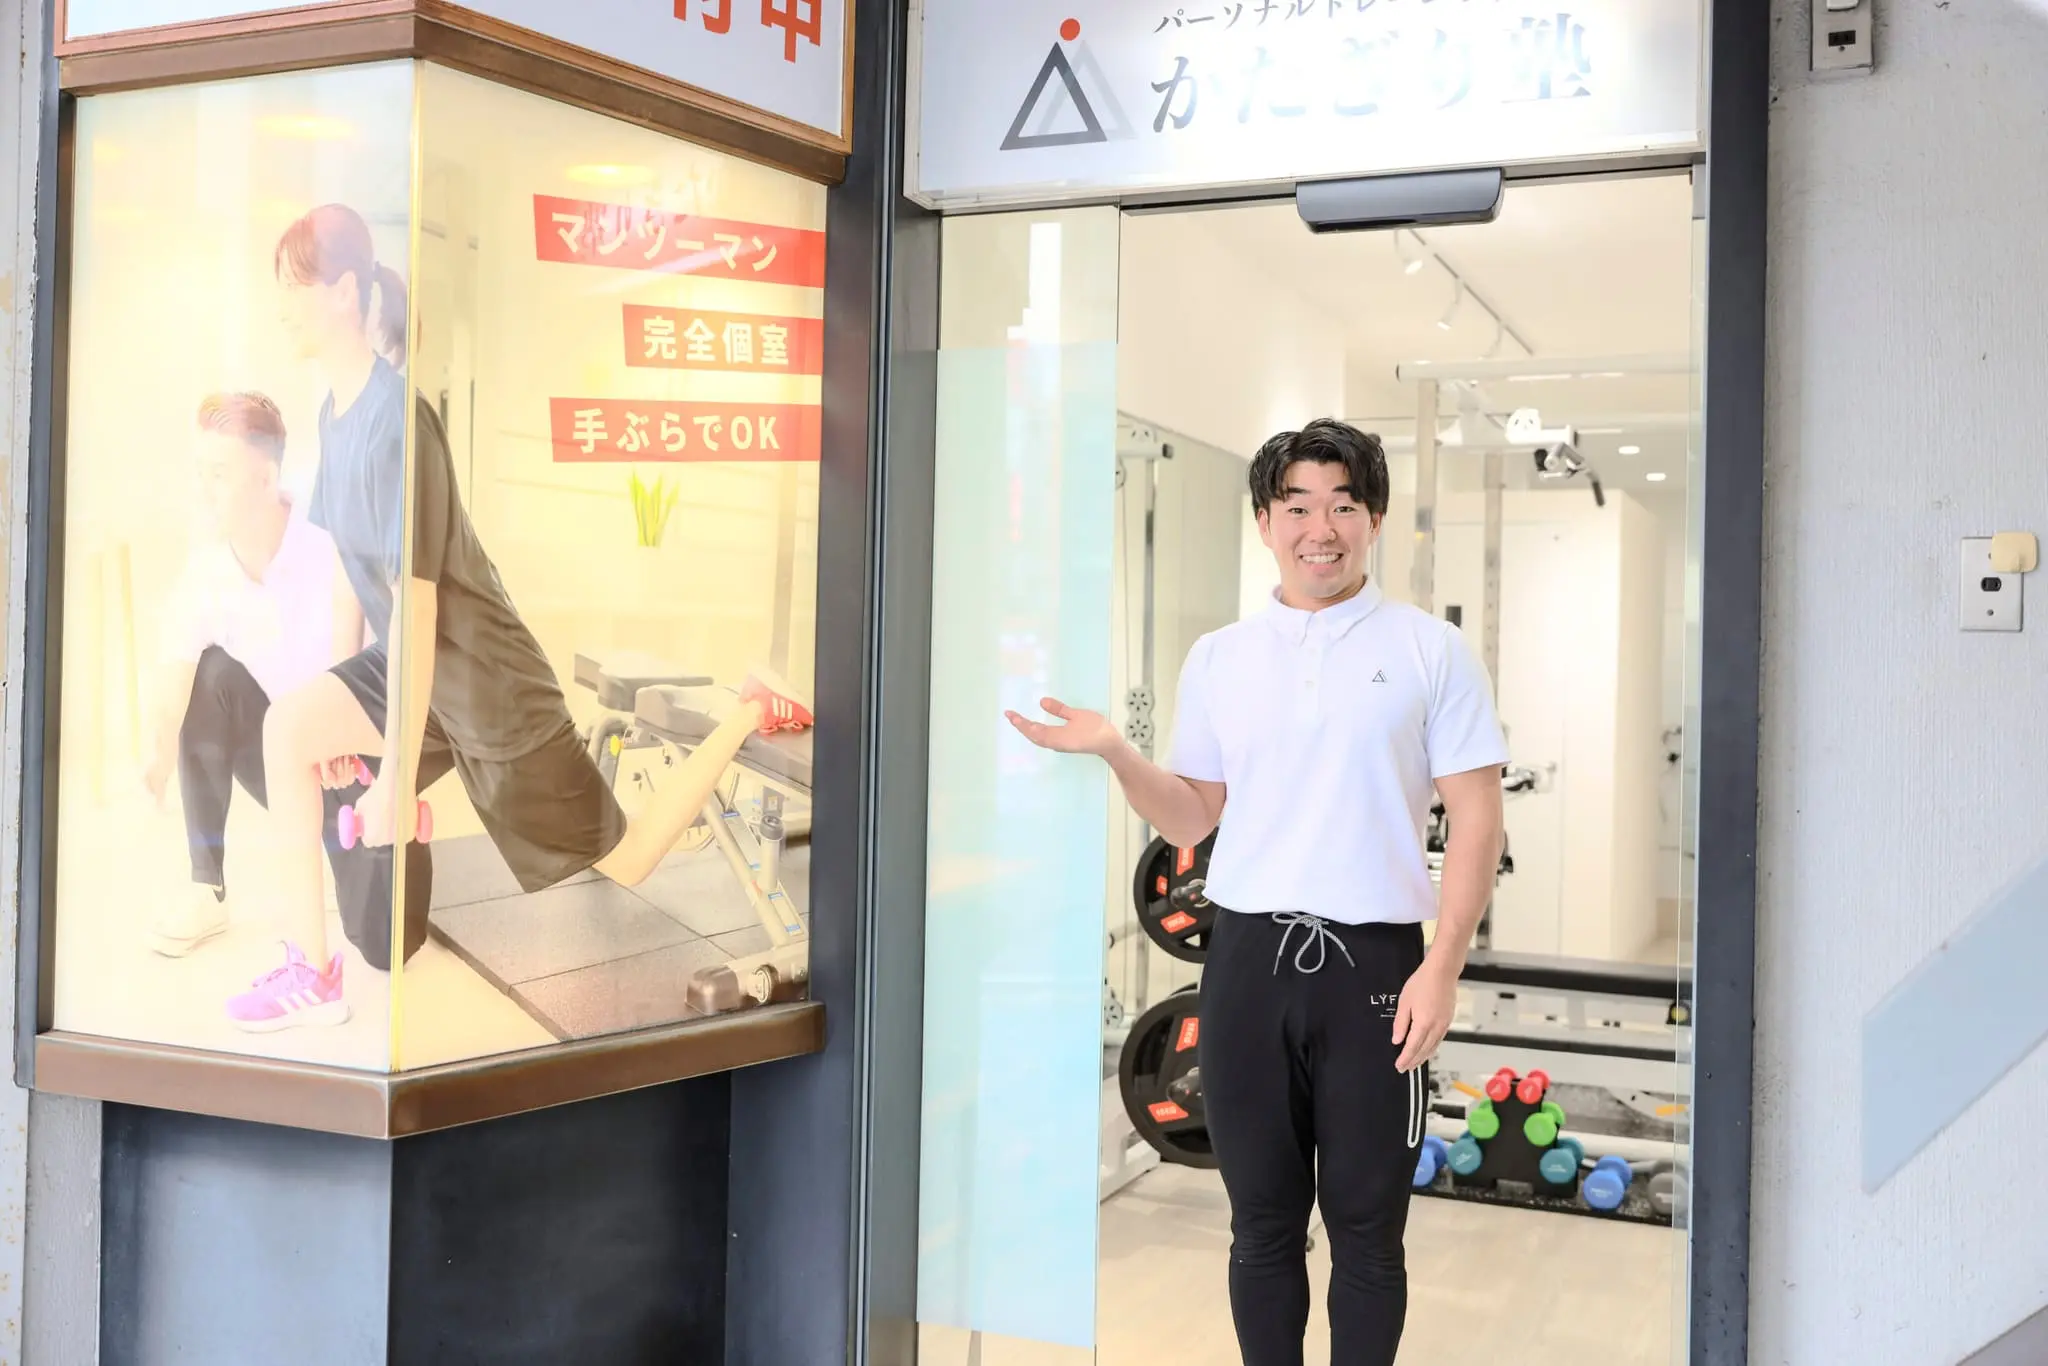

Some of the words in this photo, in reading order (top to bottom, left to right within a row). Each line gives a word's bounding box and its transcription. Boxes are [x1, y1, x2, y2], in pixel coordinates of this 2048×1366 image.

[551, 211, 778, 272] マンツーマン
[642, 314, 789, 366] 完全個室
[572, 407, 780, 454] 手ぶらでOK
